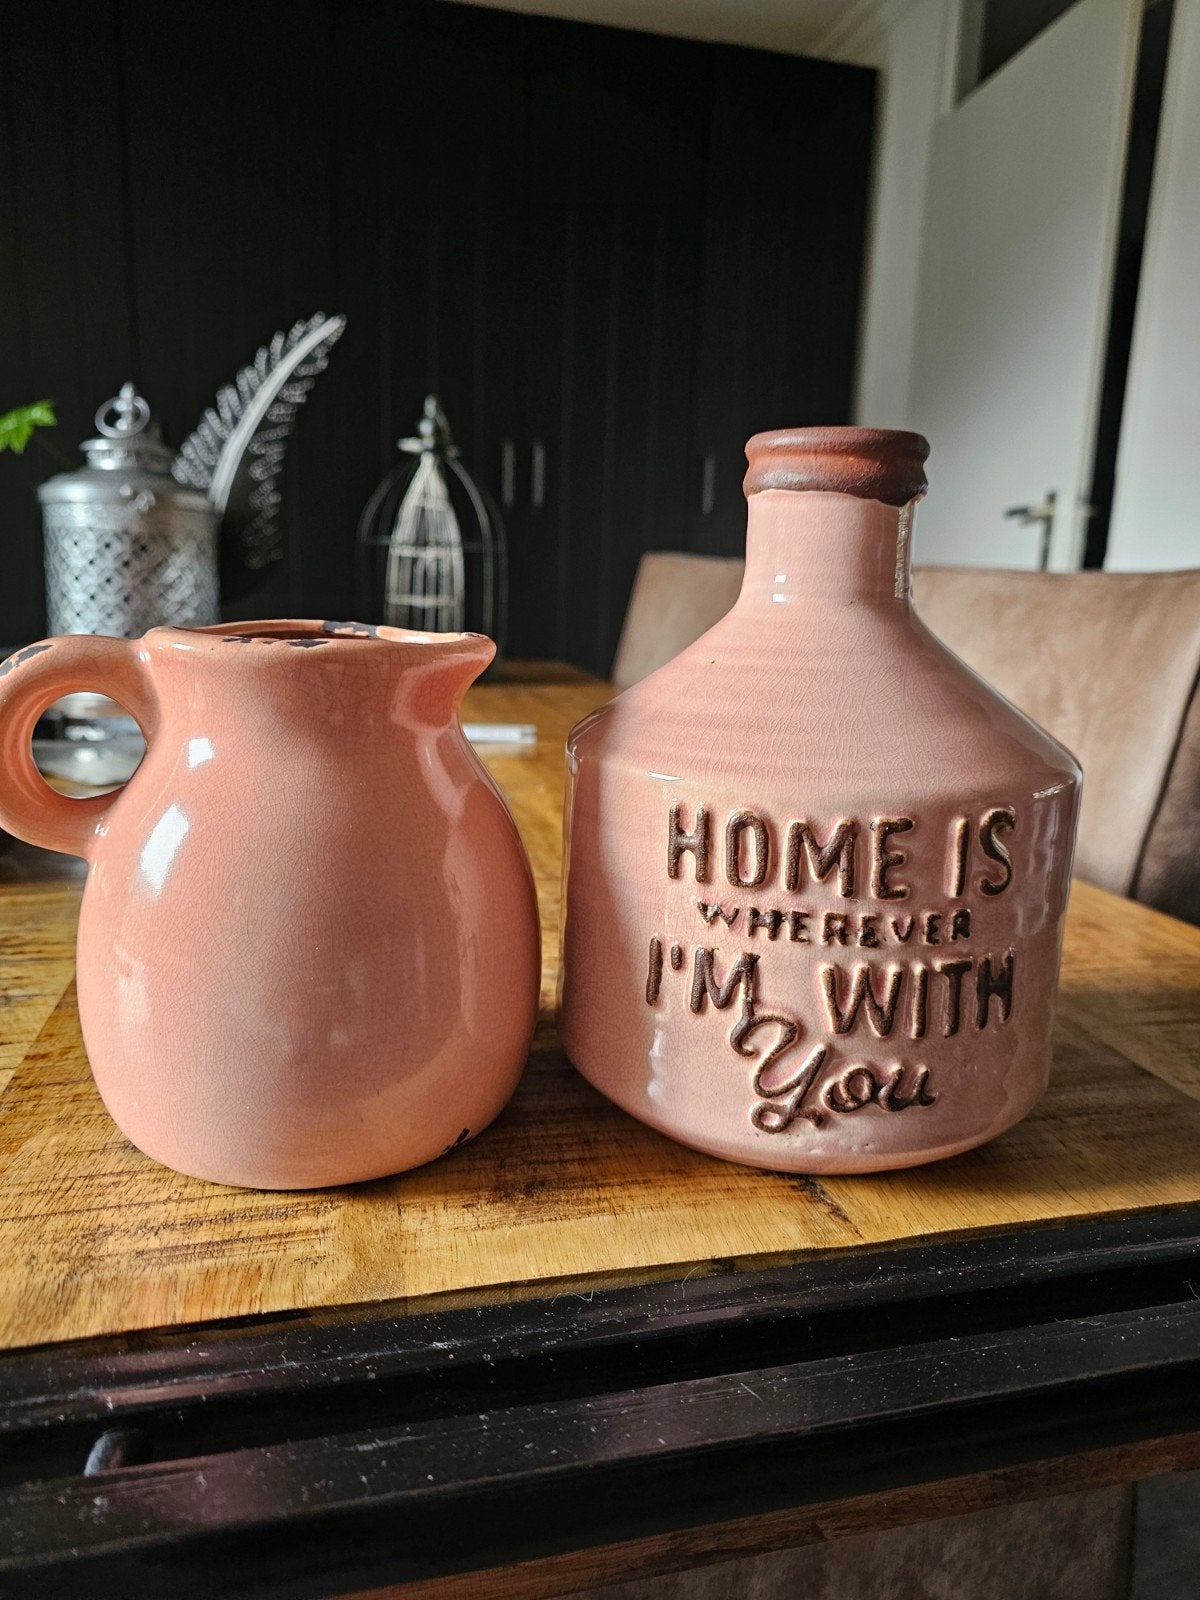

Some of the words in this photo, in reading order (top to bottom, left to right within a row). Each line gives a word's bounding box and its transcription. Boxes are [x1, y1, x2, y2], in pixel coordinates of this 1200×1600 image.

[667, 803, 914, 899] HOME
[948, 806, 1016, 897] IS
[697, 900, 972, 947] WHEREVER
[646, 935, 761, 1014] I'M
[820, 946, 1015, 1039] WITH
[730, 1010, 938, 1134] You
